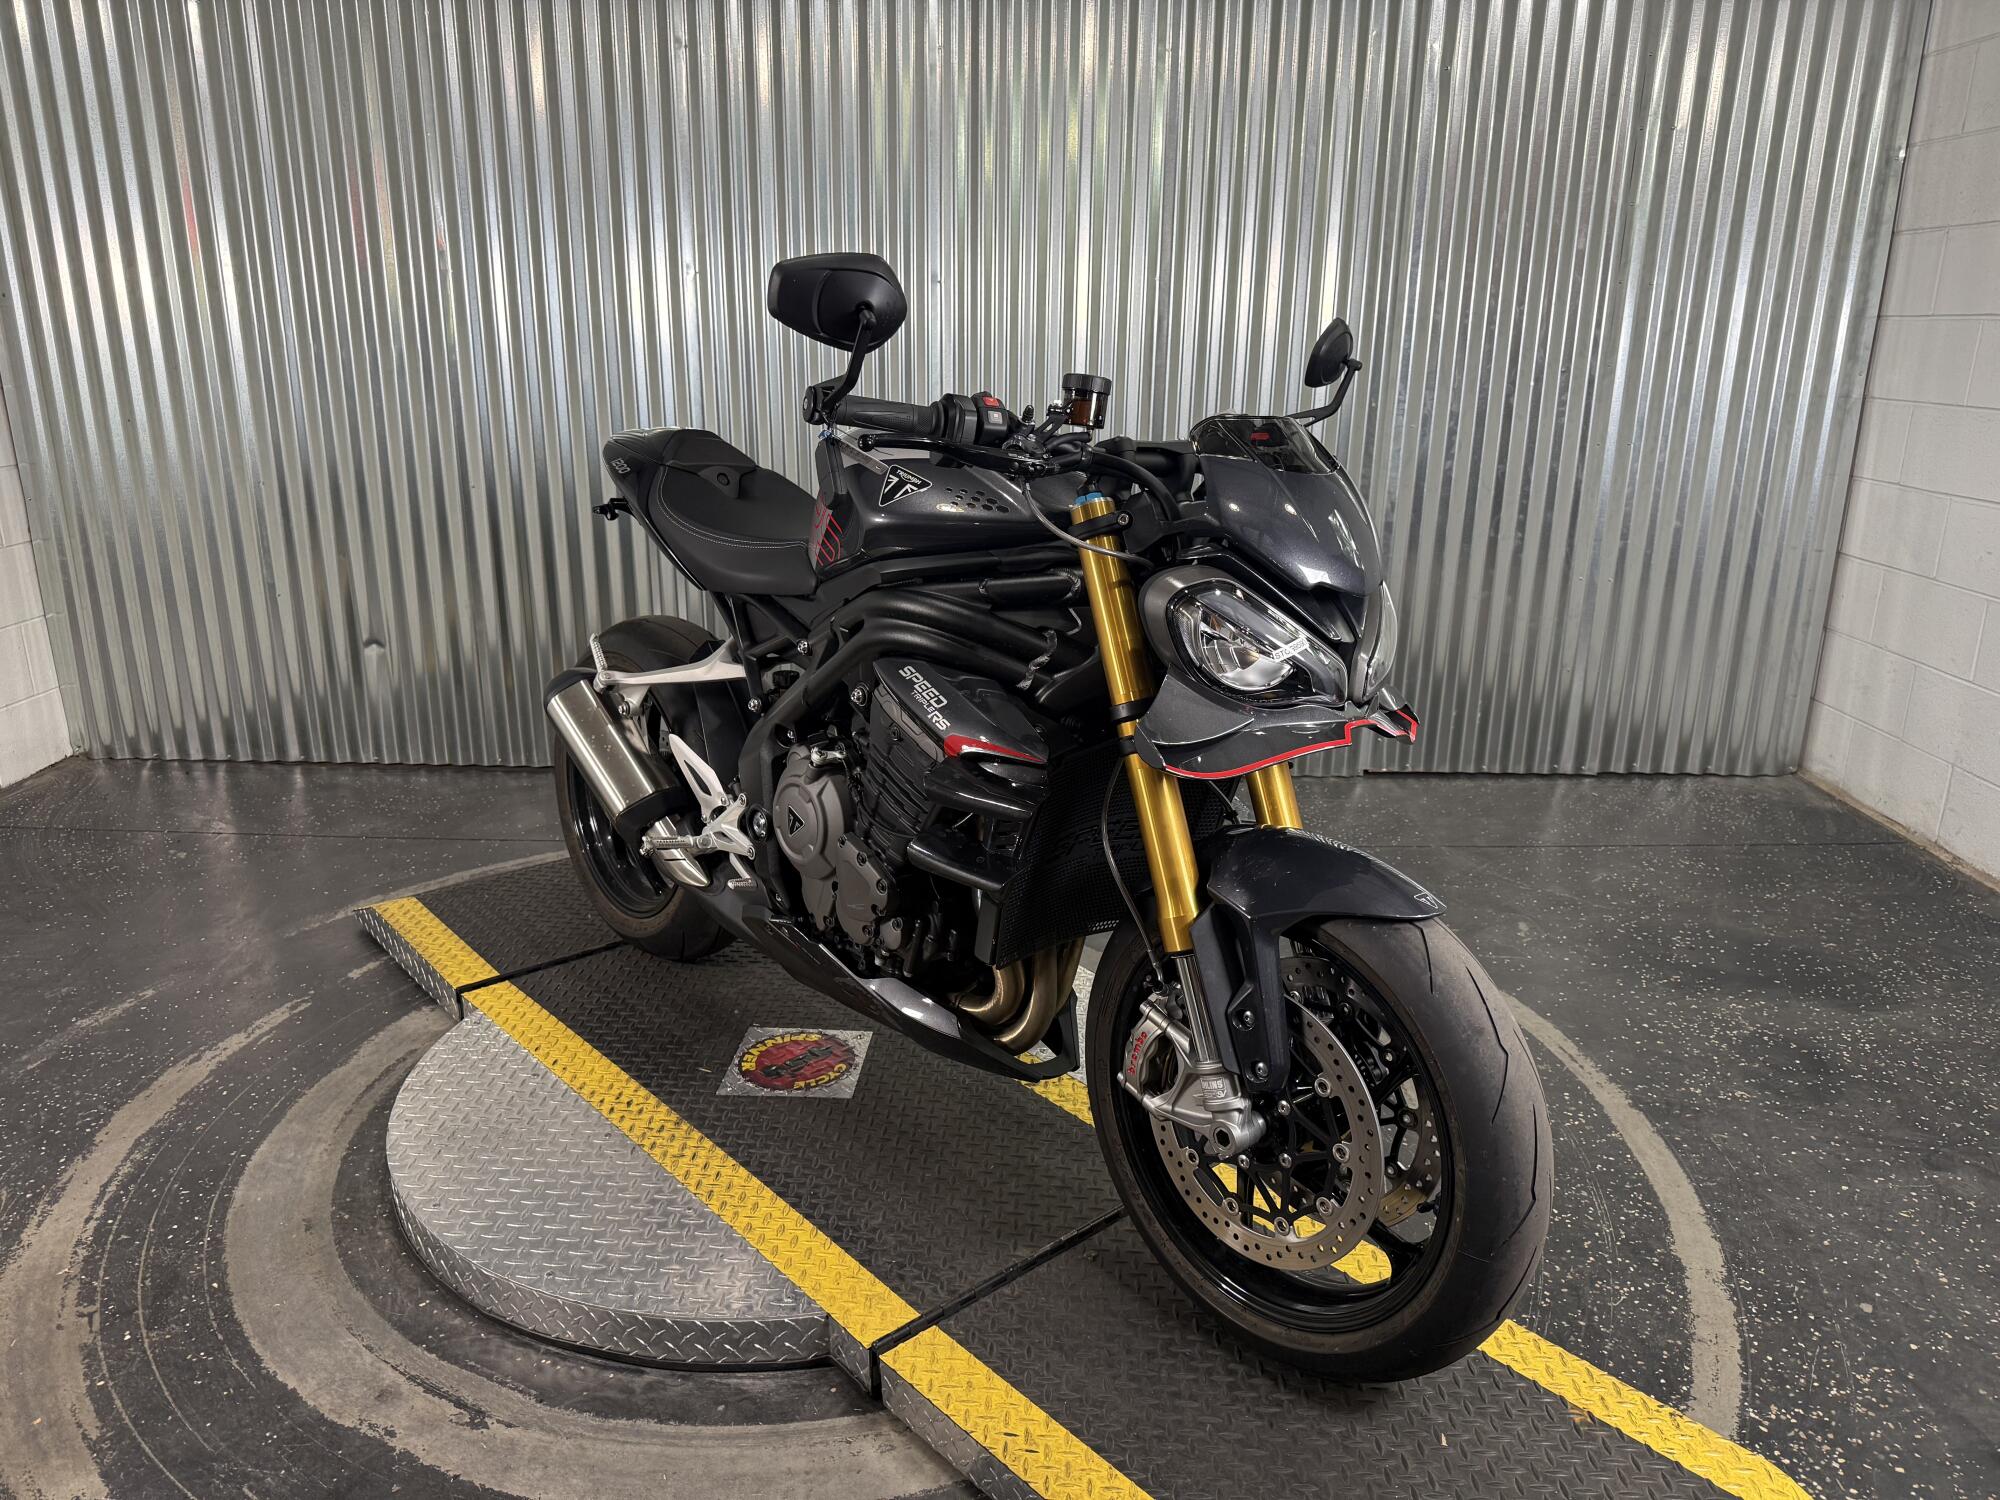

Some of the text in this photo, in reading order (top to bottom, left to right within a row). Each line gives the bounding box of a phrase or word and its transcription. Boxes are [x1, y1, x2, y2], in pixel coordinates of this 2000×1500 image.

[610, 457, 631, 474] 1200
[896, 469, 922, 485] TRIUMPH
[898, 665, 948, 709] SPEED
[911, 689, 936, 713] TRIPLE
[927, 710, 951, 731] RS
[741, 1032, 822, 1072] SPINNER
[1126, 1031, 1148, 1076] brembo
[793, 1063, 847, 1089] CYCLE
